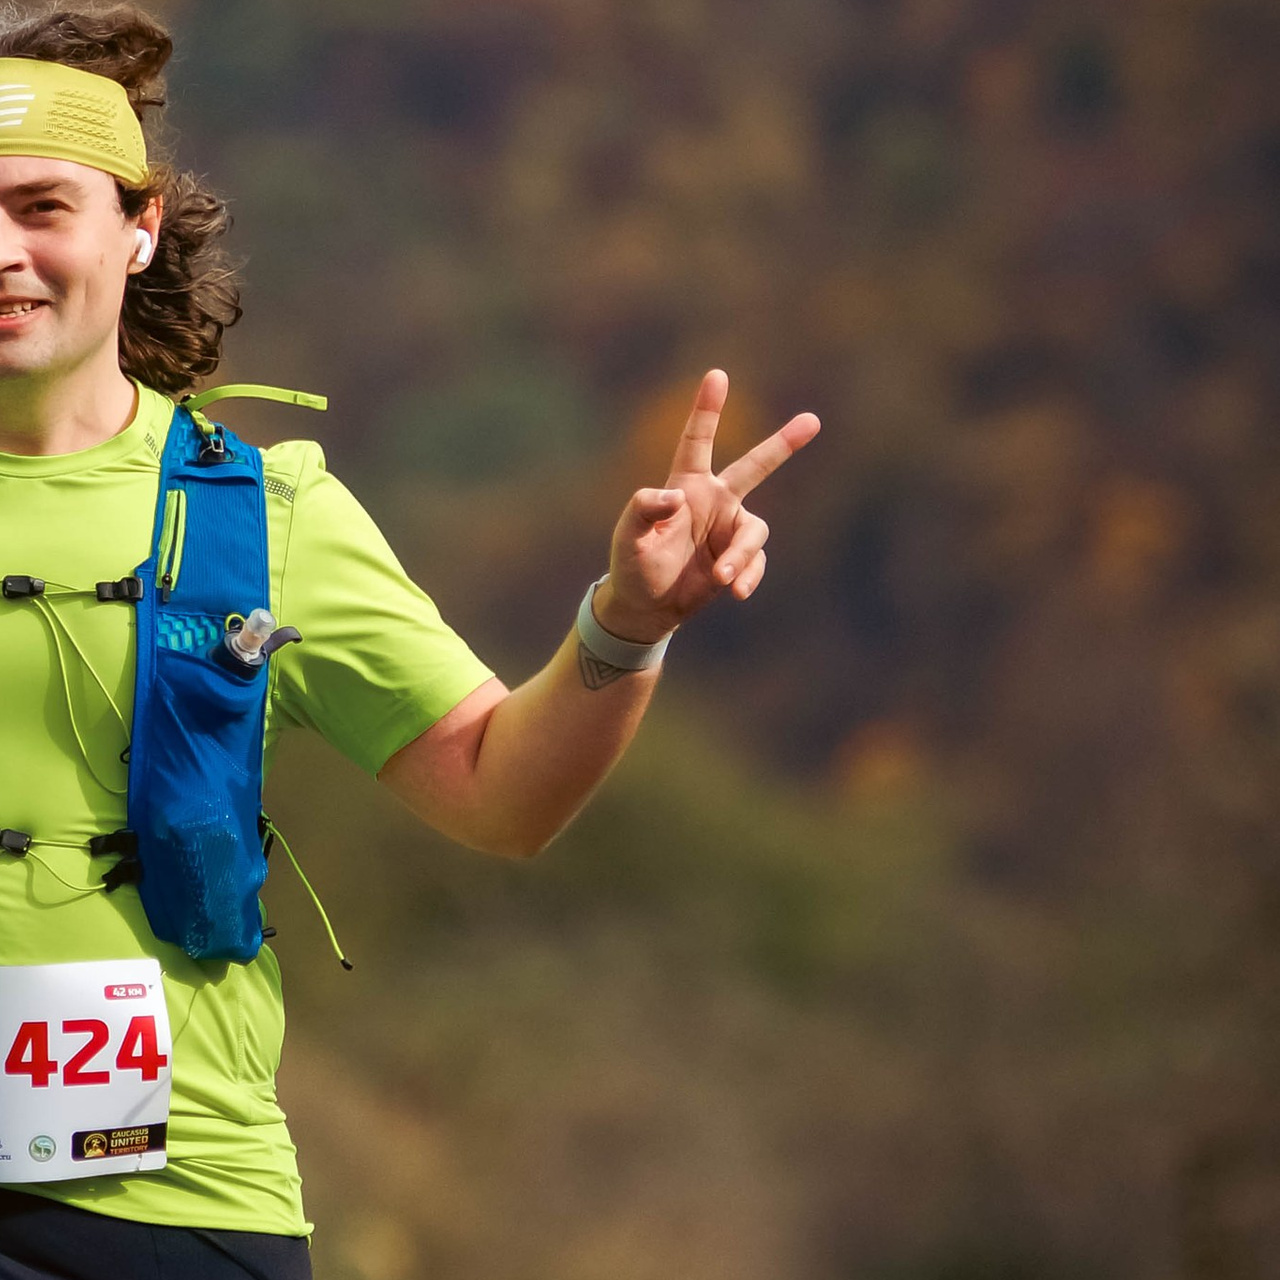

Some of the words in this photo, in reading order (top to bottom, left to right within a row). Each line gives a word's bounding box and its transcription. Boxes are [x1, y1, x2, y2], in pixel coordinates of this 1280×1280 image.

[113, 987, 127, 997] 42
[5, 1015, 168, 1088] 424
[111, 1127, 149, 1139] CAUCASUS
[110, 1135, 149, 1148] UNITED
[110, 1145, 149, 1155] TERRITORY
